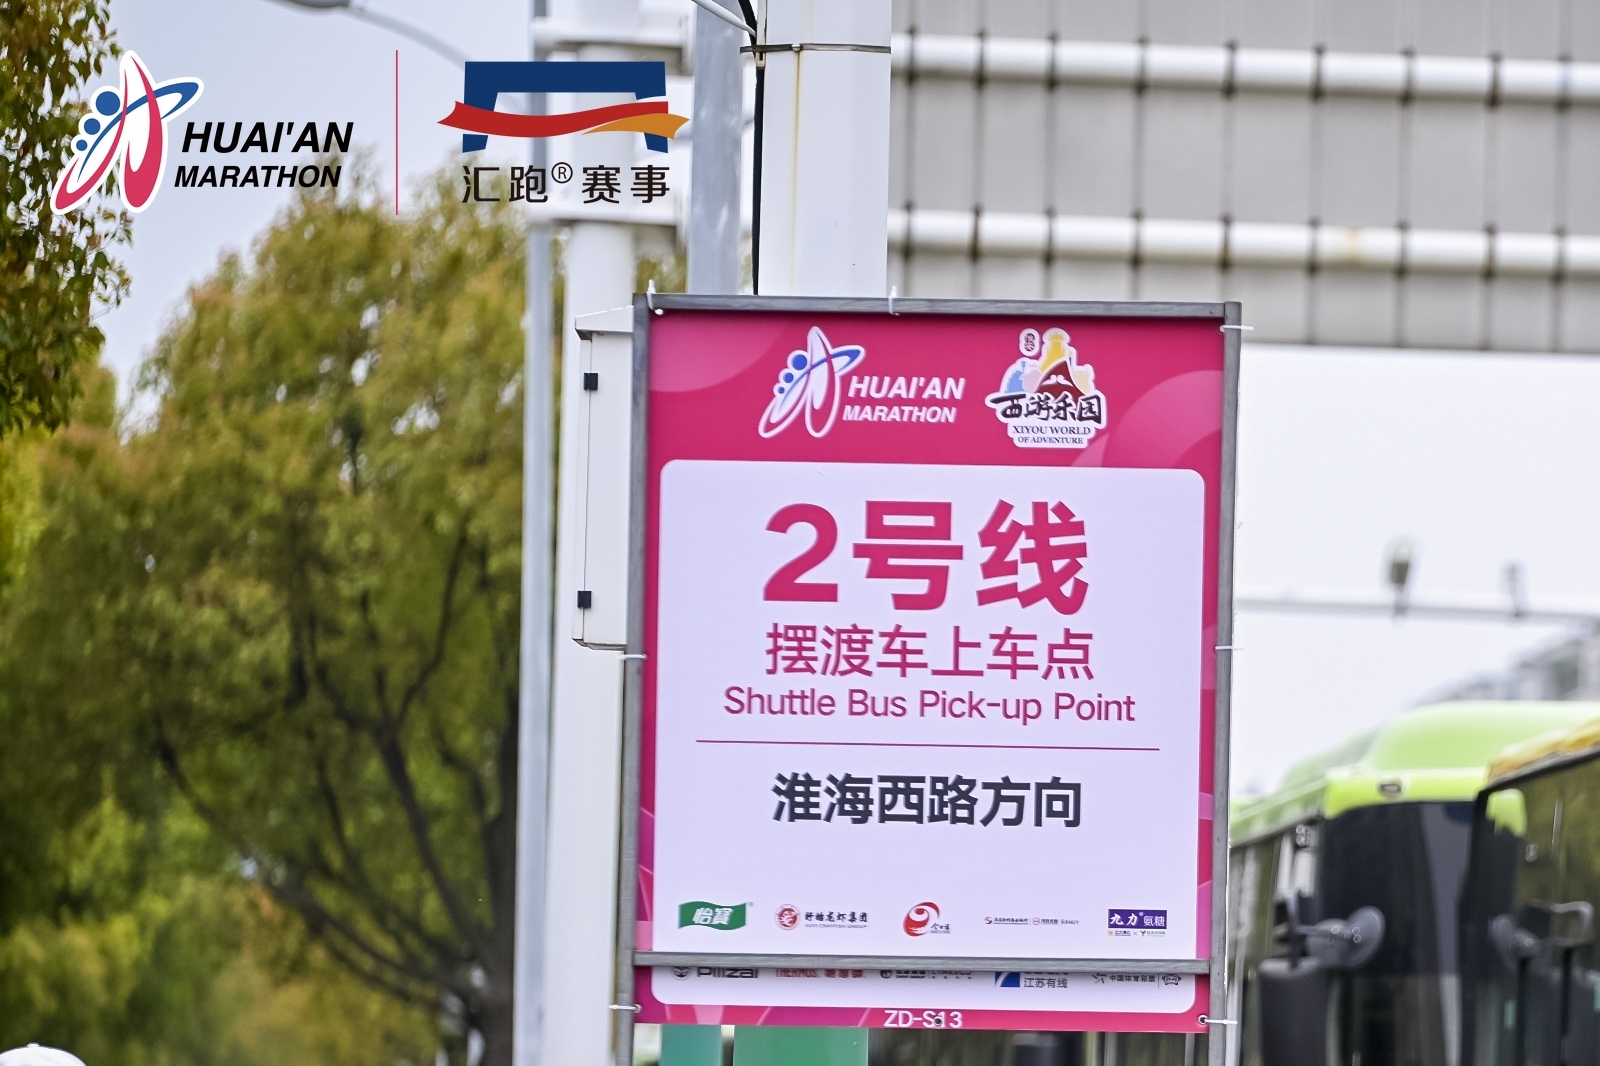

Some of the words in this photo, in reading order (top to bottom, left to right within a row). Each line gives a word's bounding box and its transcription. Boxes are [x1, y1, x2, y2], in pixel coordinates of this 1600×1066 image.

[847, 375, 965, 401] HUAI'AN
[842, 404, 957, 424] MARATHON
[989, 392, 1102, 424] 西游乐园
[1013, 425, 1047, 435] XIYOU
[1050, 426, 1091, 436] WORLD
[1017, 436, 1029, 444] OF
[1030, 436, 1084, 445] ADVENTURE
[763, 499, 1090, 615] 2号线
[765, 622, 1095, 680] 摆渡车上车点
[723, 685, 836, 716] Shuttle
[848, 689, 908, 719] Bus
[919, 690, 1042, 726] Pick-up
[1054, 692, 1136, 722] Point
[771, 771, 1083, 829] 淮海西路方向
[1023, 977, 1068, 989] 江苏有线
[883, 1009, 962, 1029] ZD-S13
